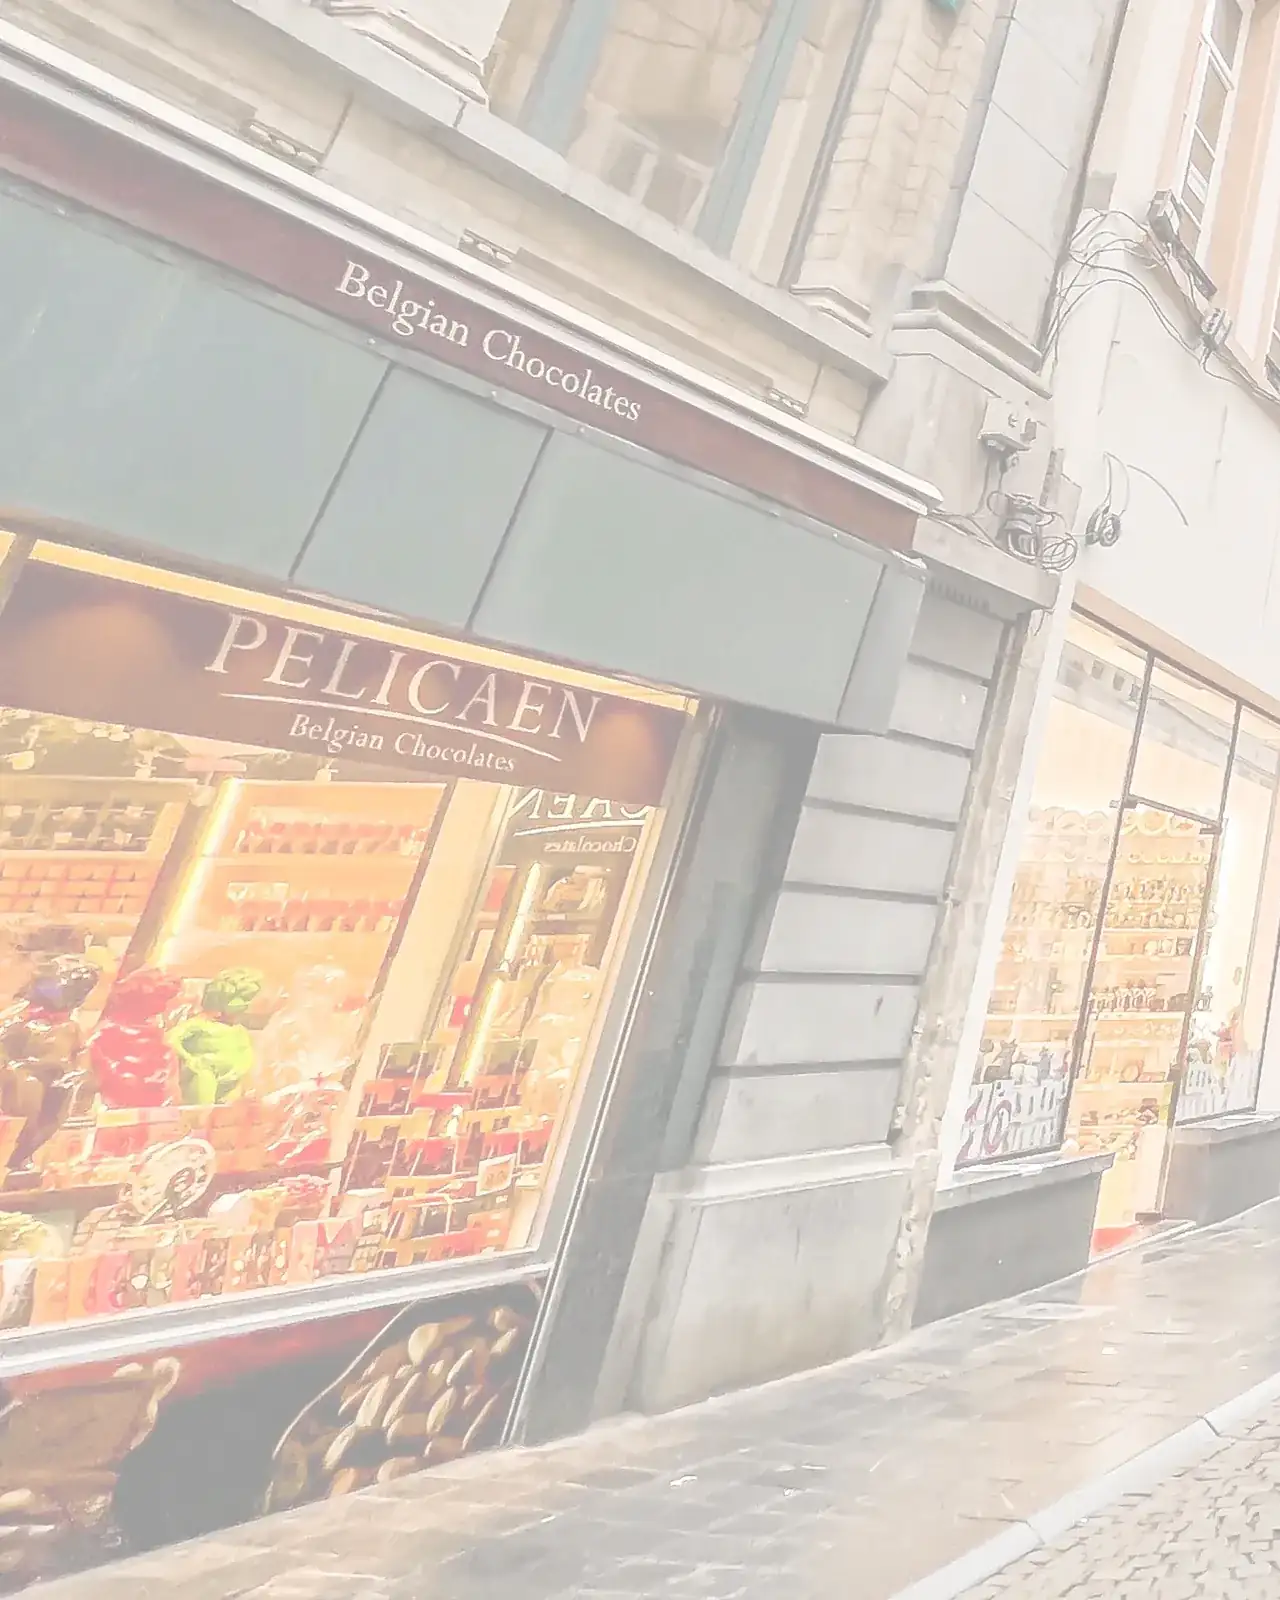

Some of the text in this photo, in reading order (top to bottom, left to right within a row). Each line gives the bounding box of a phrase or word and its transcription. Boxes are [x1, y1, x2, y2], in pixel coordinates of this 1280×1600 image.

[335, 260, 642, 422] Belgian Chocolates
[204, 612, 601, 744] PELICAEN
[288, 713, 517, 773] Belgian Chocolates
